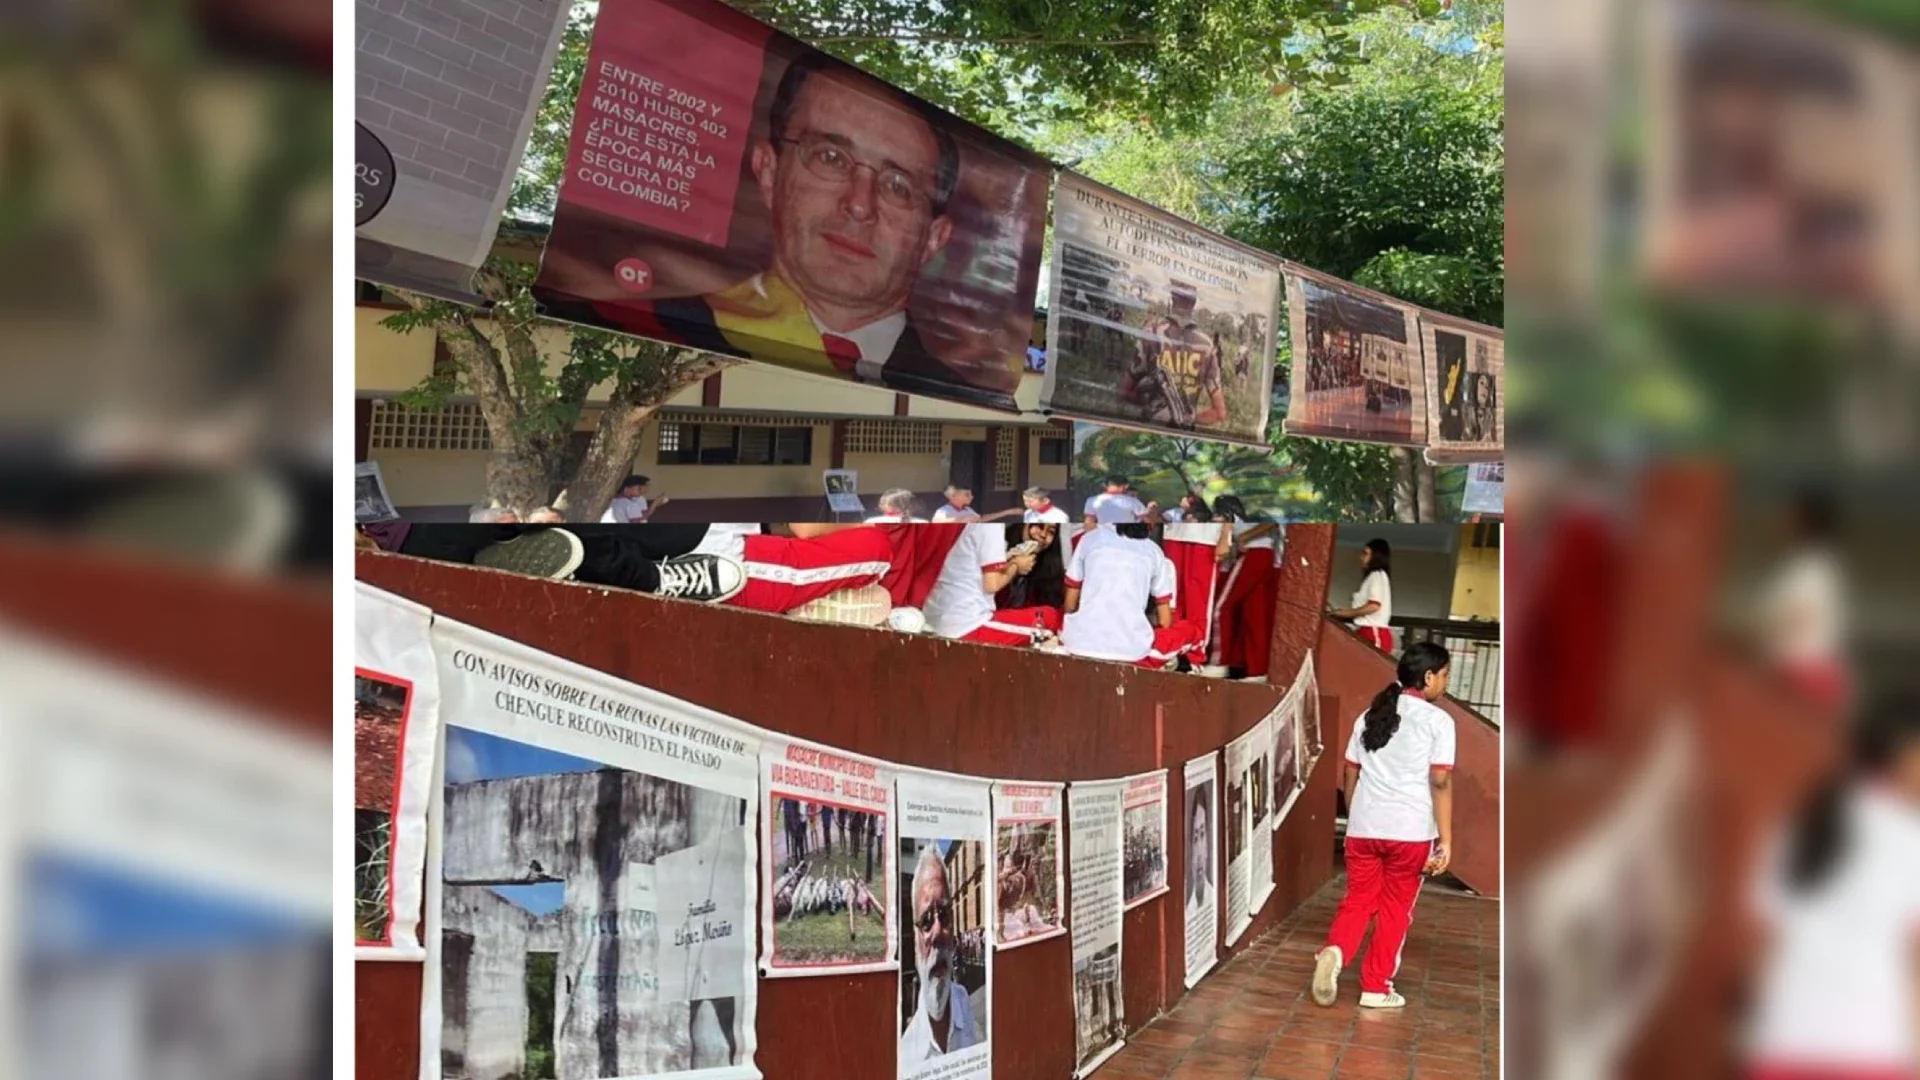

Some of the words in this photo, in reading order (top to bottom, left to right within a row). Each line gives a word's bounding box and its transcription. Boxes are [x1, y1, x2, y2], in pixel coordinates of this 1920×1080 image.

[597, 80, 638, 105] 2010
[643, 97, 696, 126] HUBO
[700, 119, 728, 139] 402
[600, 61, 664, 97] ENTRE
[668, 88, 708, 113] 2002
[710, 104, 723, 118] Y
[589, 117, 640, 142] ¿FUE
[645, 133, 690, 160] ESTA
[694, 150, 716, 169] LA
[577, 167, 691, 213] COLOMBIA?
[581, 149, 662, 186] SEGURA
[666, 177, 692, 196] DE
[657, 155, 697, 180] MÁS
[1077, 188, 1134, 222] DURANTE
[1101, 215, 1190, 259] AUTODEFENSAS
[1106, 235, 1120, 250] EL
[1124, 240, 1172, 269] TERROR
[1173, 259, 1187, 273] EN
[620, 266, 648, 285] or
[453, 649, 489, 676] CON
[489, 662, 542, 693] AVISOS
[543, 678, 588, 707] SOBRE
[589, 694, 616, 713] LAS
[614, 703, 660, 730] RUINAS
[660, 717, 684, 737] LAS
[683, 725, 733, 751] VICTIMAS
[732, 740, 748, 757] DE
[495, 690, 566, 727] CHENGUE
[568, 712, 666, 756] RECONSTRUYEN
[666, 741, 681, 760] EL
[681, 745, 722, 770] PASADO
